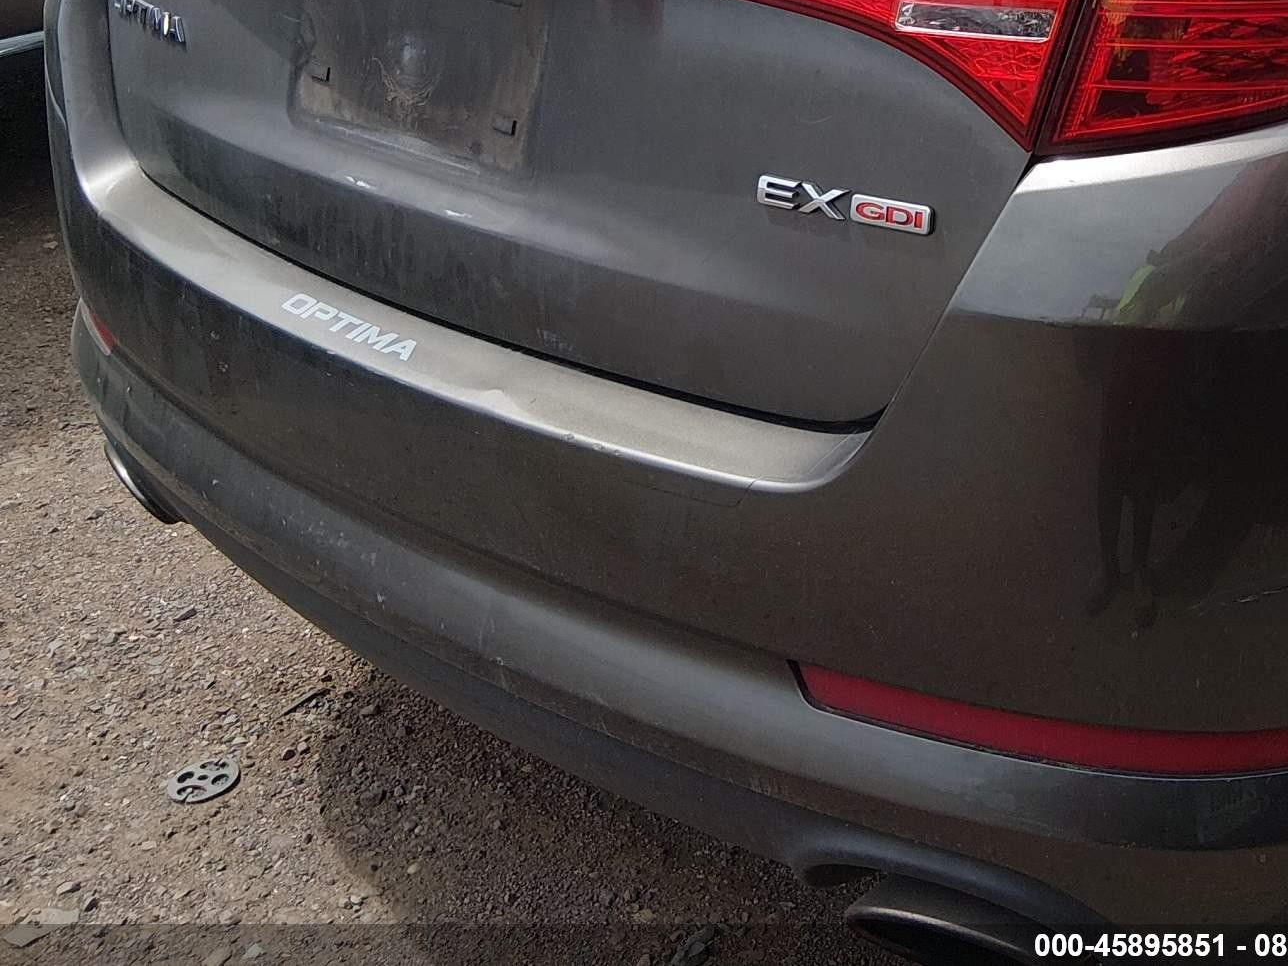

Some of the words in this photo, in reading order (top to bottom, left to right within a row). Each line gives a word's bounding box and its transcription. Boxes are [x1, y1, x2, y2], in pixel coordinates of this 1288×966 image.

[757, 175, 851, 221] EX
[855, 201, 924, 229] GDI
[281, 293, 417, 361] OPTIMA
